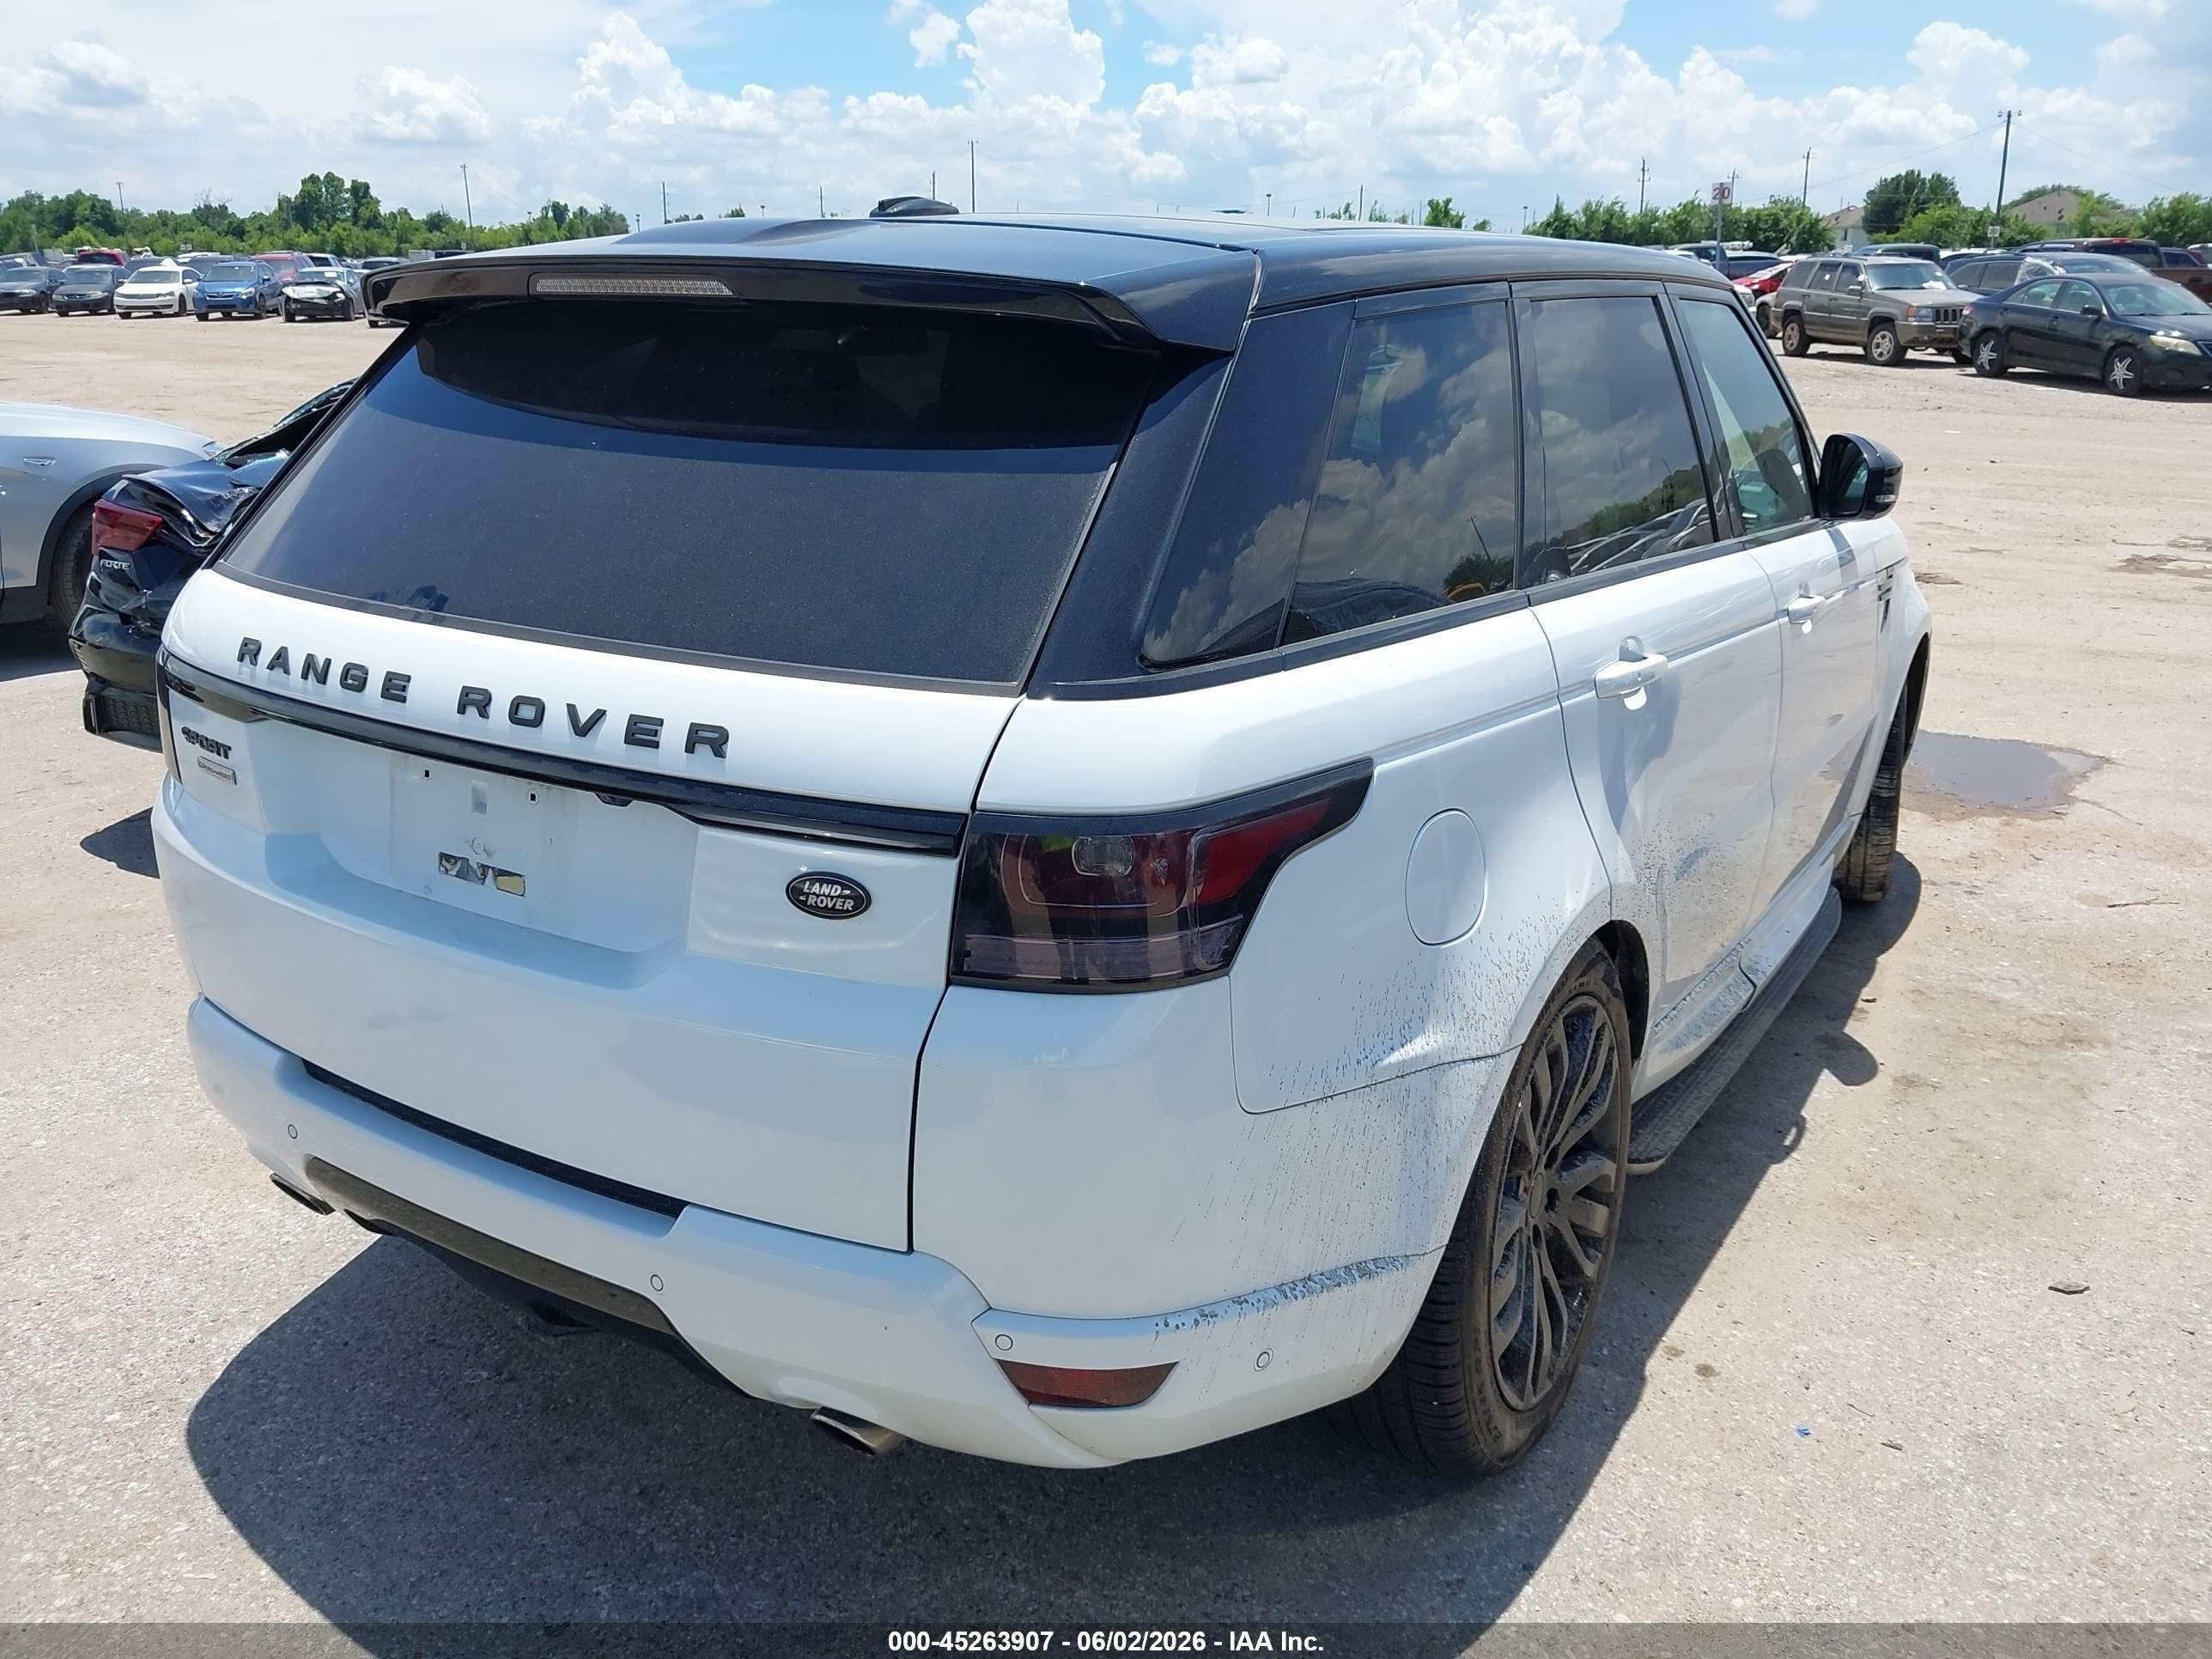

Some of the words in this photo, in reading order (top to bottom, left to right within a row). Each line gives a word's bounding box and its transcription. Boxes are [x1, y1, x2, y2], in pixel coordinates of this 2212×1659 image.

[1712, 187, 1730, 200] 20
[100, 559, 131, 573] FORTE
[237, 636, 411, 703] RANGE
[457, 685, 730, 758] ROVER
[181, 726, 232, 760] SPORT
[803, 881, 842, 896] LAND
[806, 895, 854, 911] ROVER
